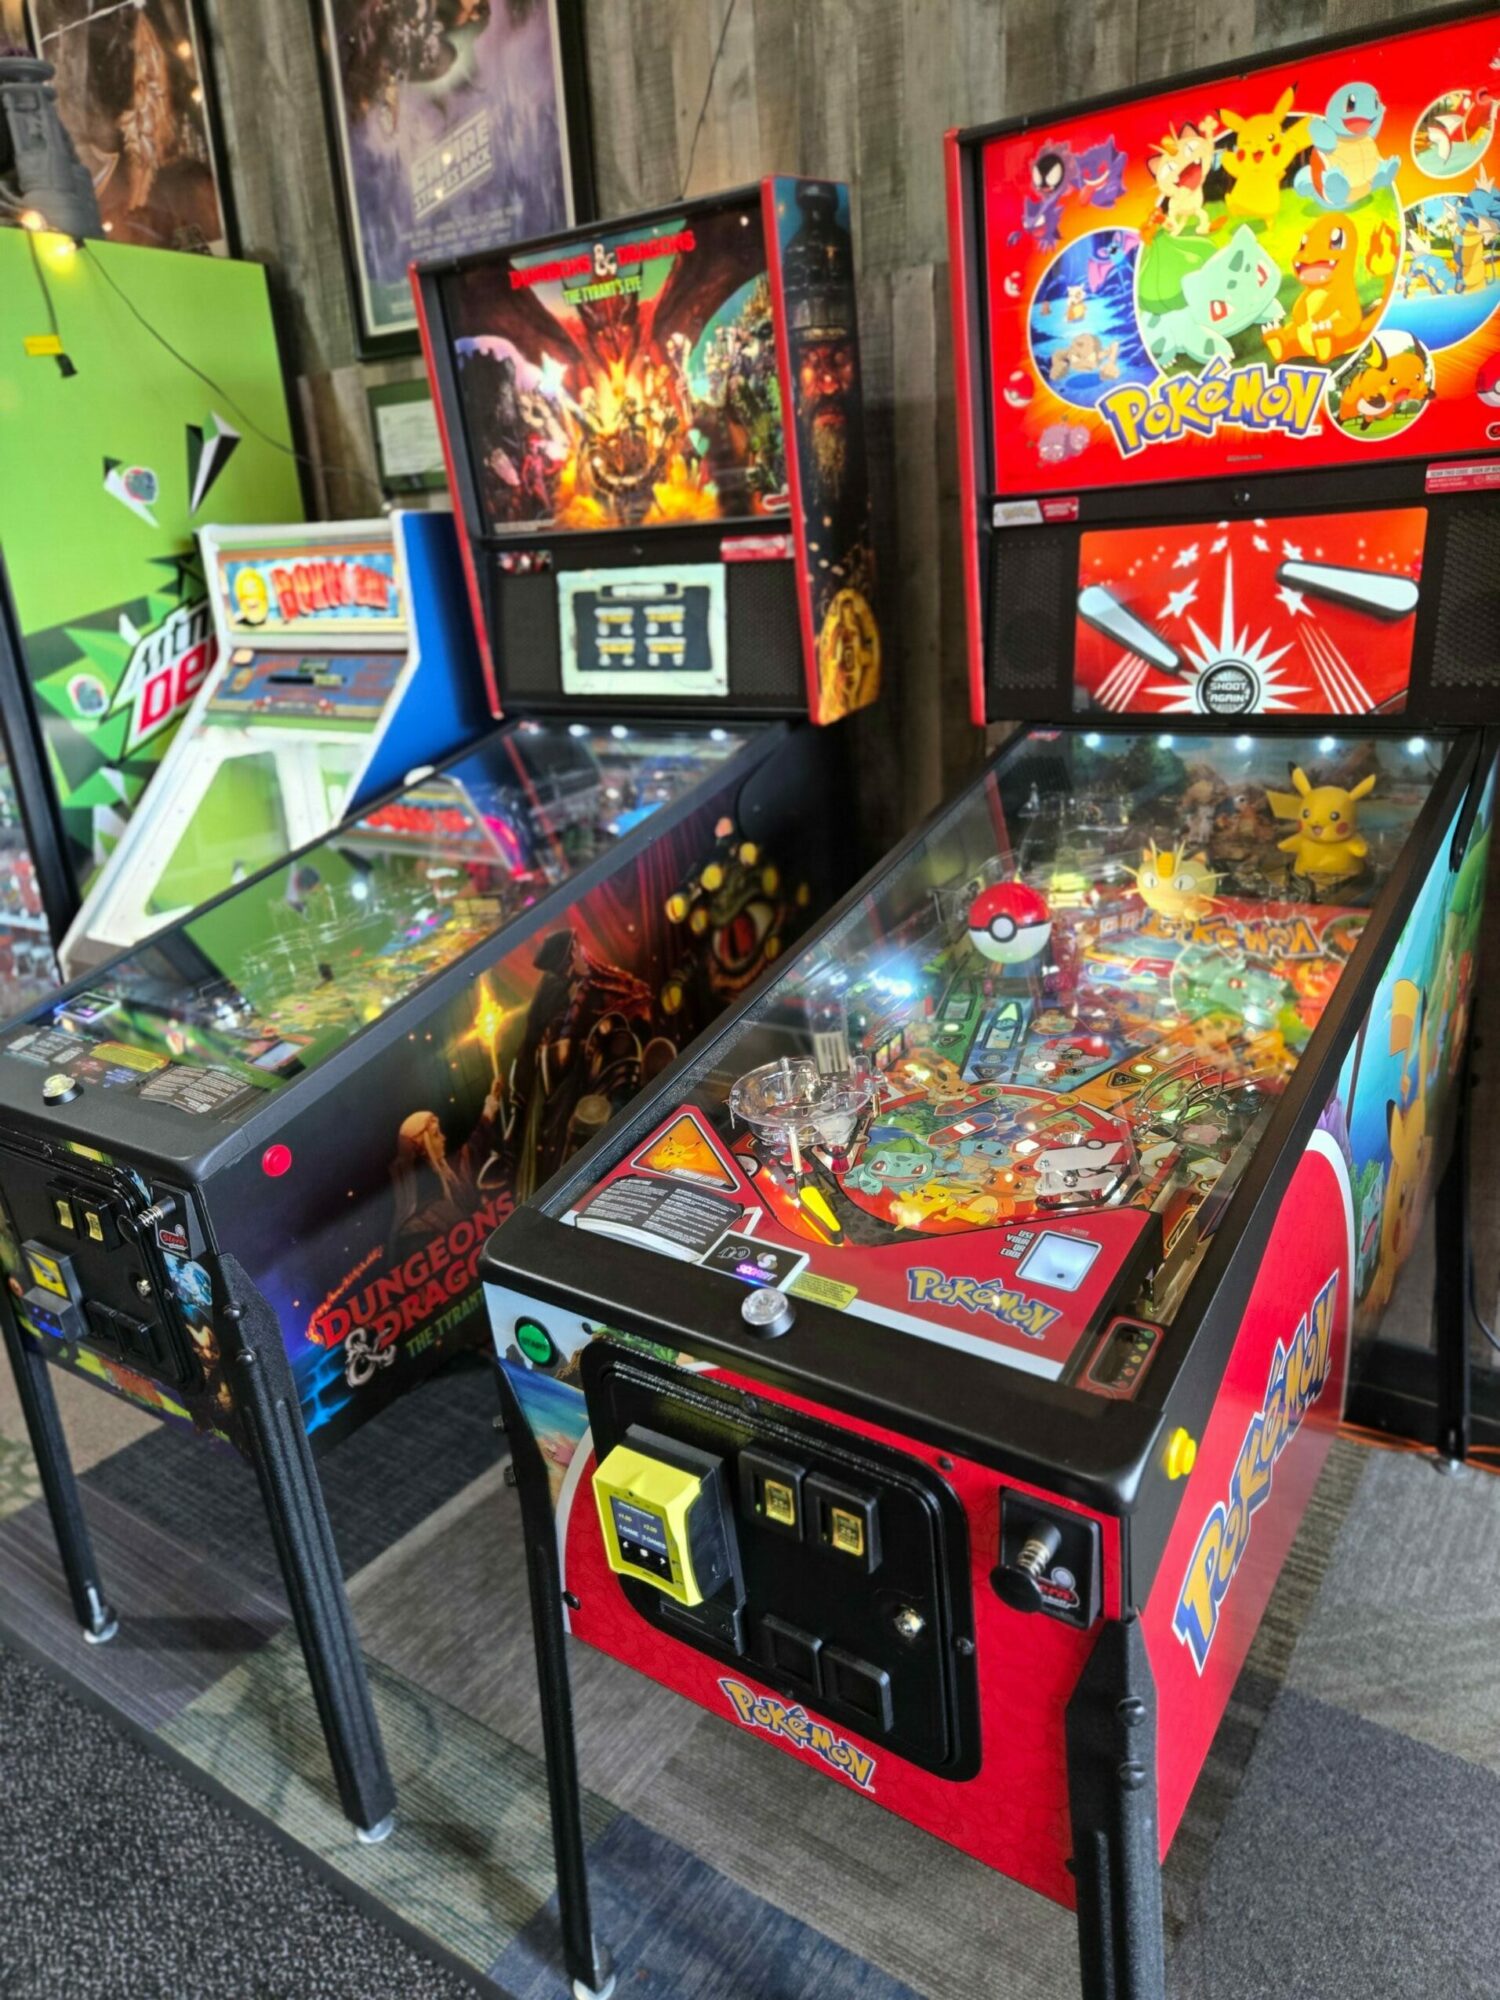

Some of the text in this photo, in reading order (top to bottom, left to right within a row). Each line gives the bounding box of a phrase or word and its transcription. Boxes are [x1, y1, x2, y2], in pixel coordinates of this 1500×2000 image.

[593, 243, 617, 276] &
[1209, 682, 1247, 691] SHOOT
[1209, 694, 1245, 703] AGAIN
[316, 1191, 515, 1349] DUNGEONS
[344, 1327, 396, 1387] &
[406, 1326, 434, 1358] THE
